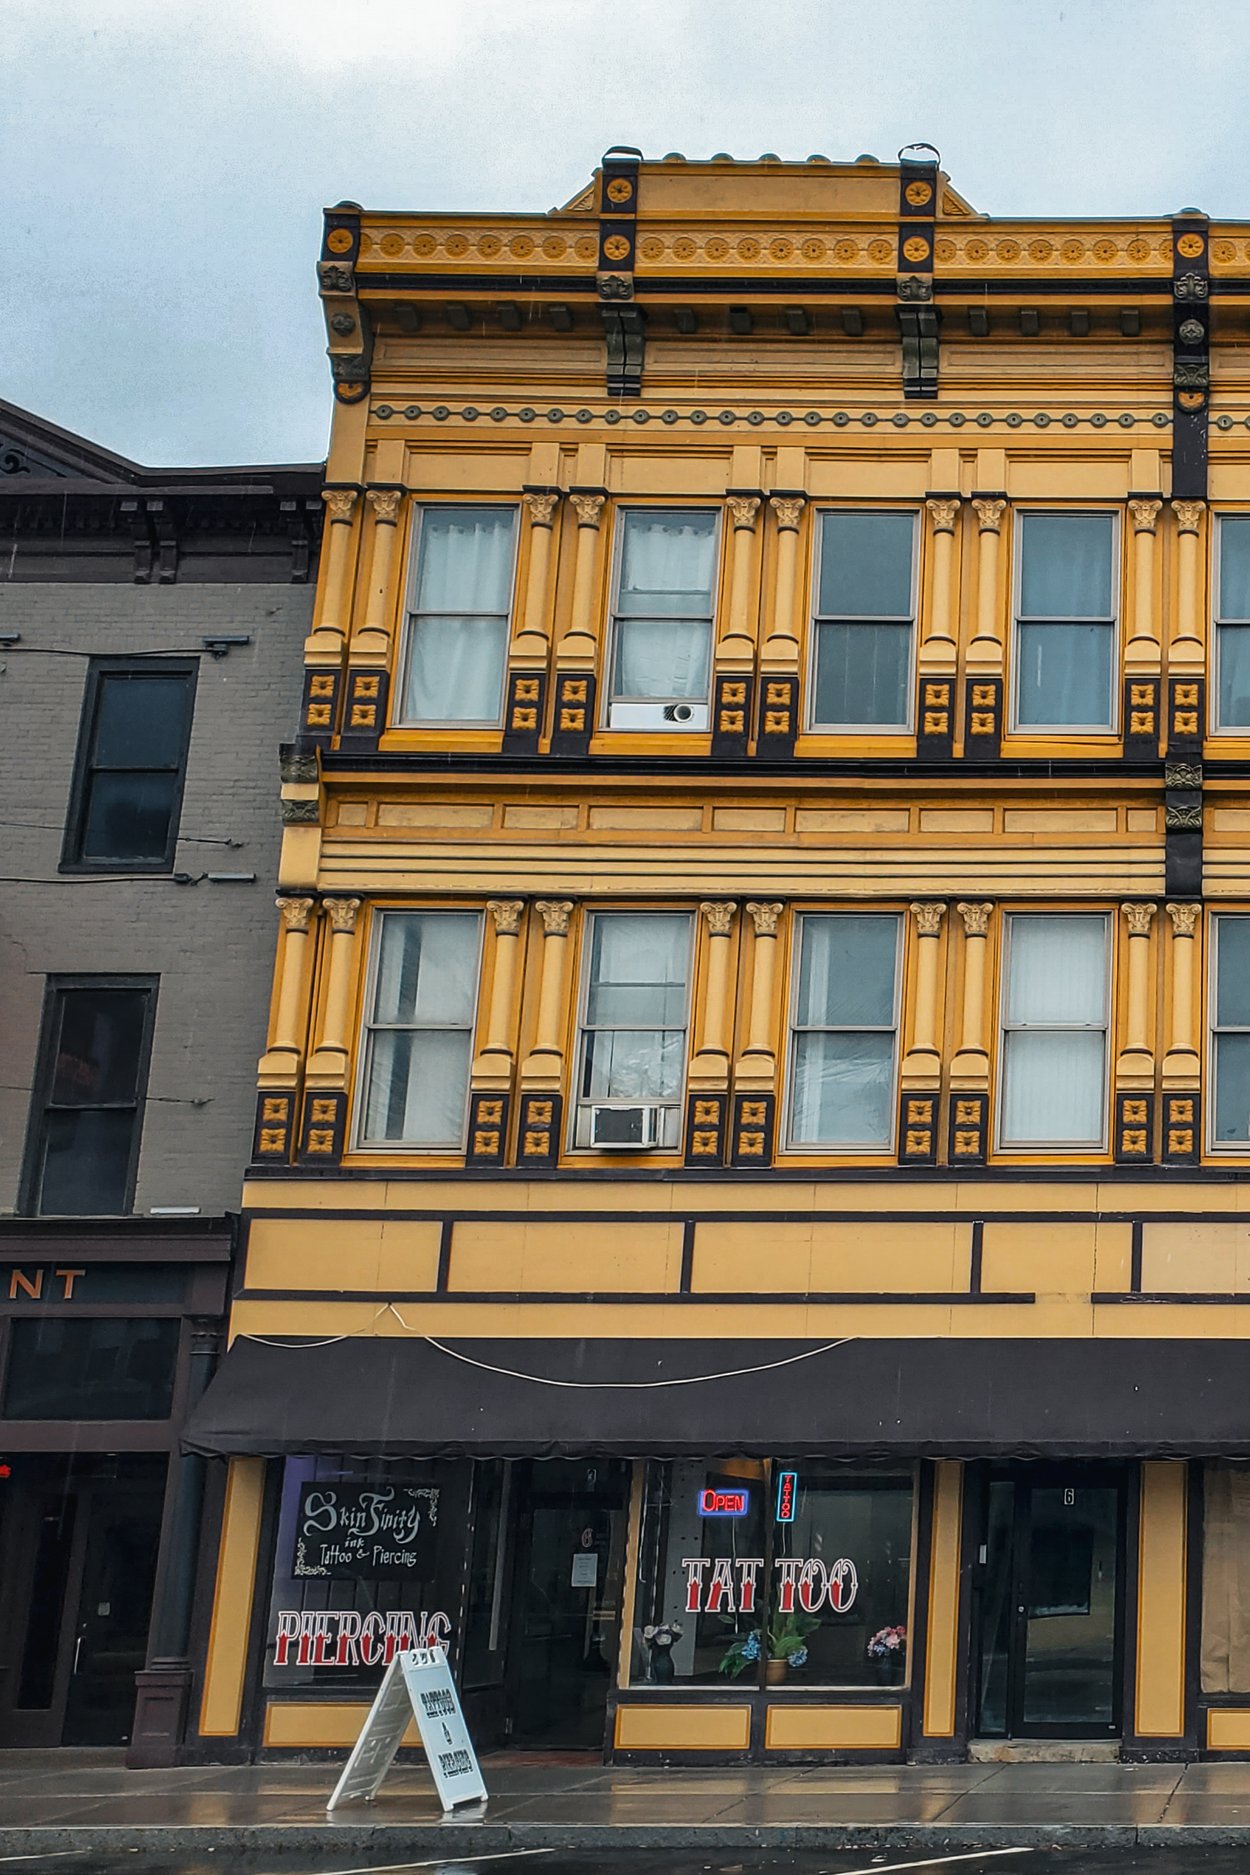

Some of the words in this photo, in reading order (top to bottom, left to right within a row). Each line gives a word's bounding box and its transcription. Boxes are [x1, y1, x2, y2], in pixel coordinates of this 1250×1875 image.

[702, 1489, 745, 1512] OPEN
[781, 1474, 792, 1518] TATTOO
[1066, 1489, 1074, 1504] 6
[344, 1536, 365, 1548] ink
[320, 1544, 352, 1565] Tattoo
[356, 1549, 370, 1559] &
[372, 1545, 417, 1568] Piercing
[273, 1611, 451, 1666] PIERCING
